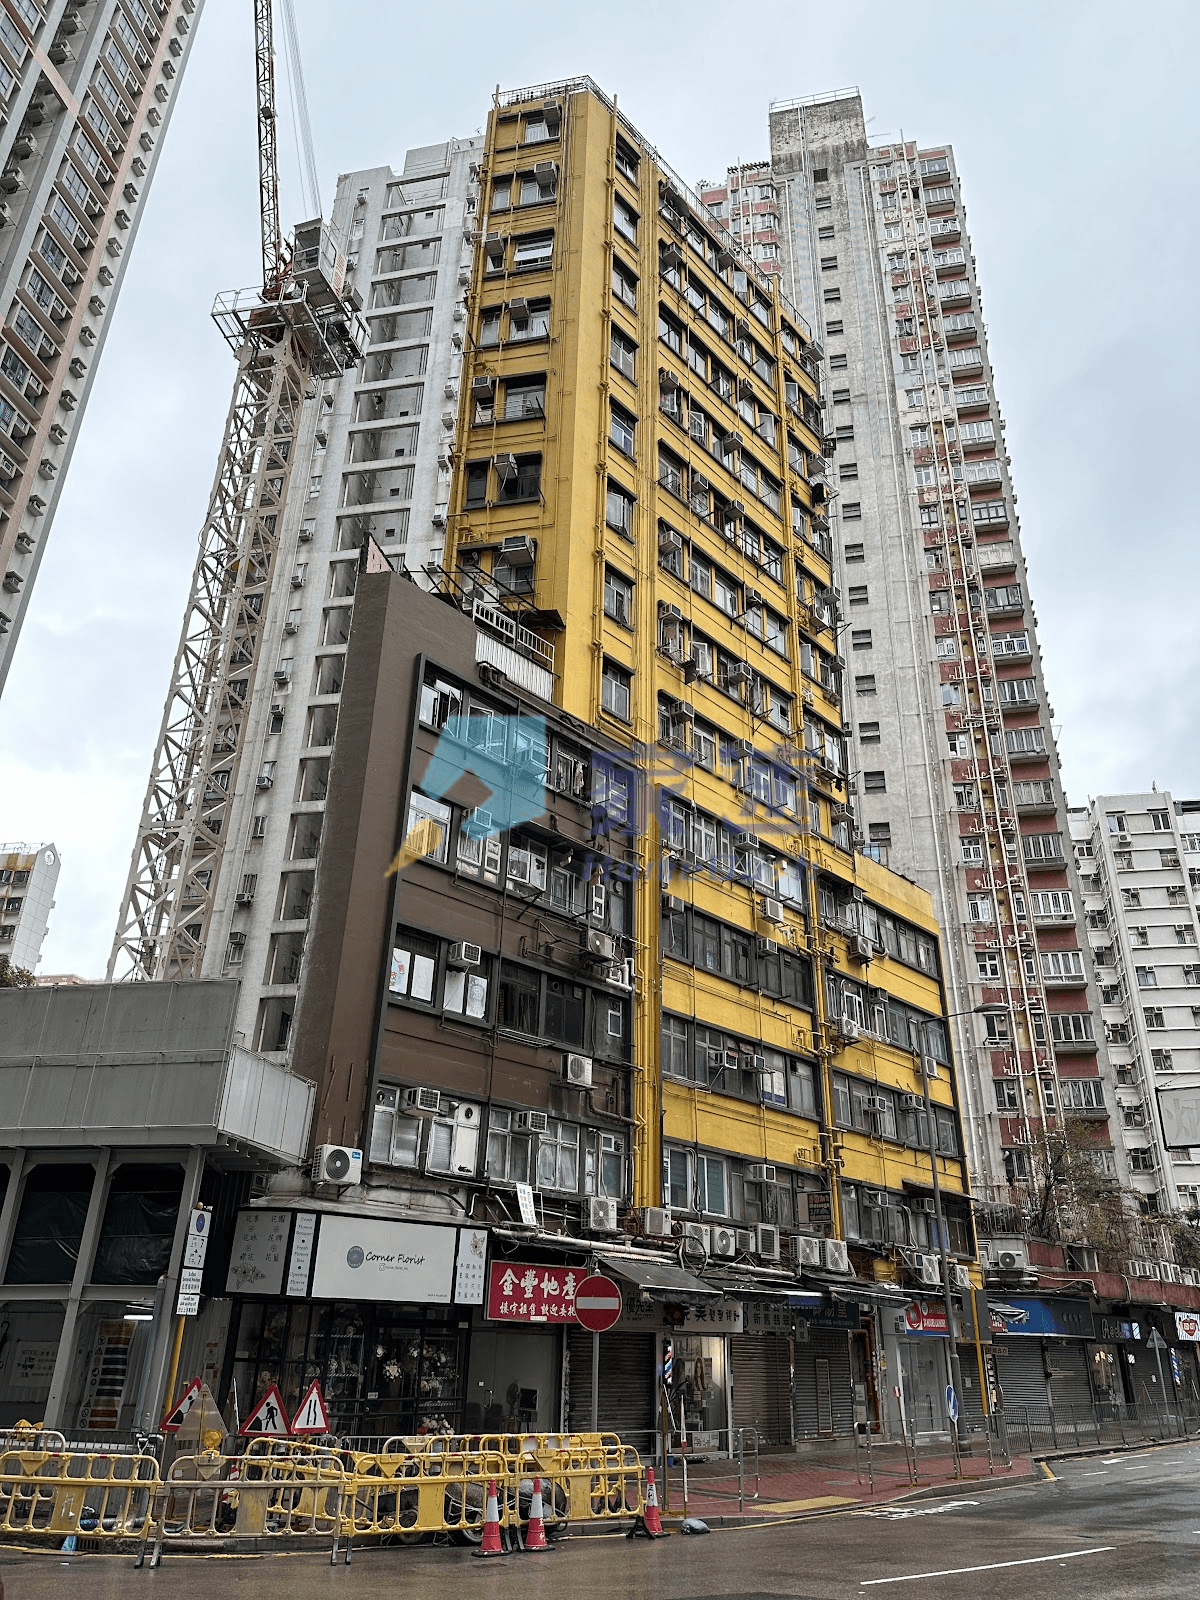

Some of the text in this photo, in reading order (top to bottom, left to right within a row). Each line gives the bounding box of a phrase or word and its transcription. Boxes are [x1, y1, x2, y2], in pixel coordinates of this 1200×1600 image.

[365, 1251, 426, 1265] Corner Florist
[498, 1268, 576, 1300] 金豐地產
[499, 1301, 537, 1316] 樓宇租售
